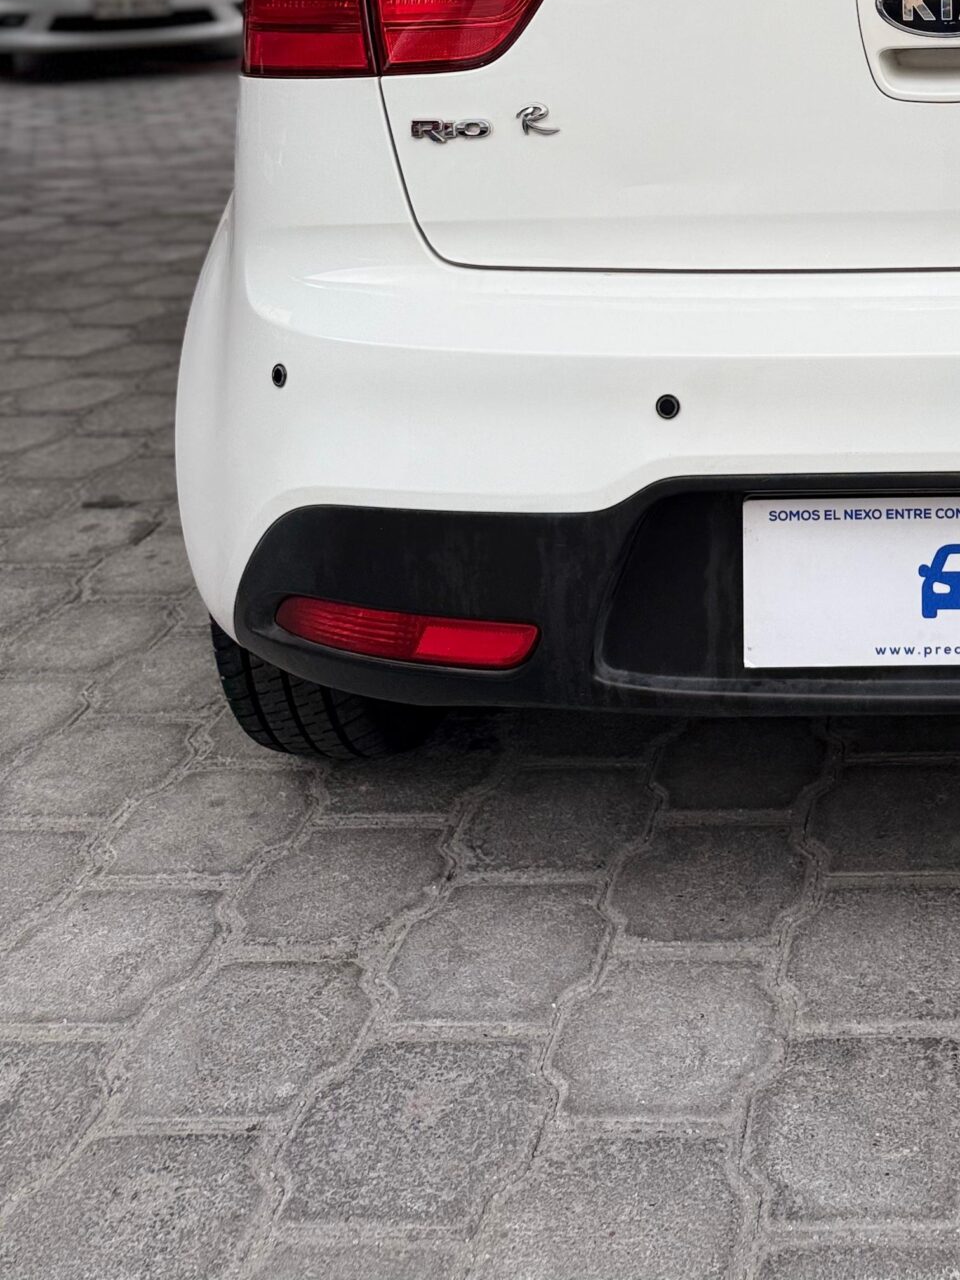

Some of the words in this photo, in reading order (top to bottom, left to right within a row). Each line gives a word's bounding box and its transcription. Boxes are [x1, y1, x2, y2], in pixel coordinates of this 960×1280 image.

[768, 509, 821, 522] SOMOS
[823, 509, 842, 521] EL
[843, 508, 883, 520] NEXO
[885, 508, 933, 520] ENTRE
